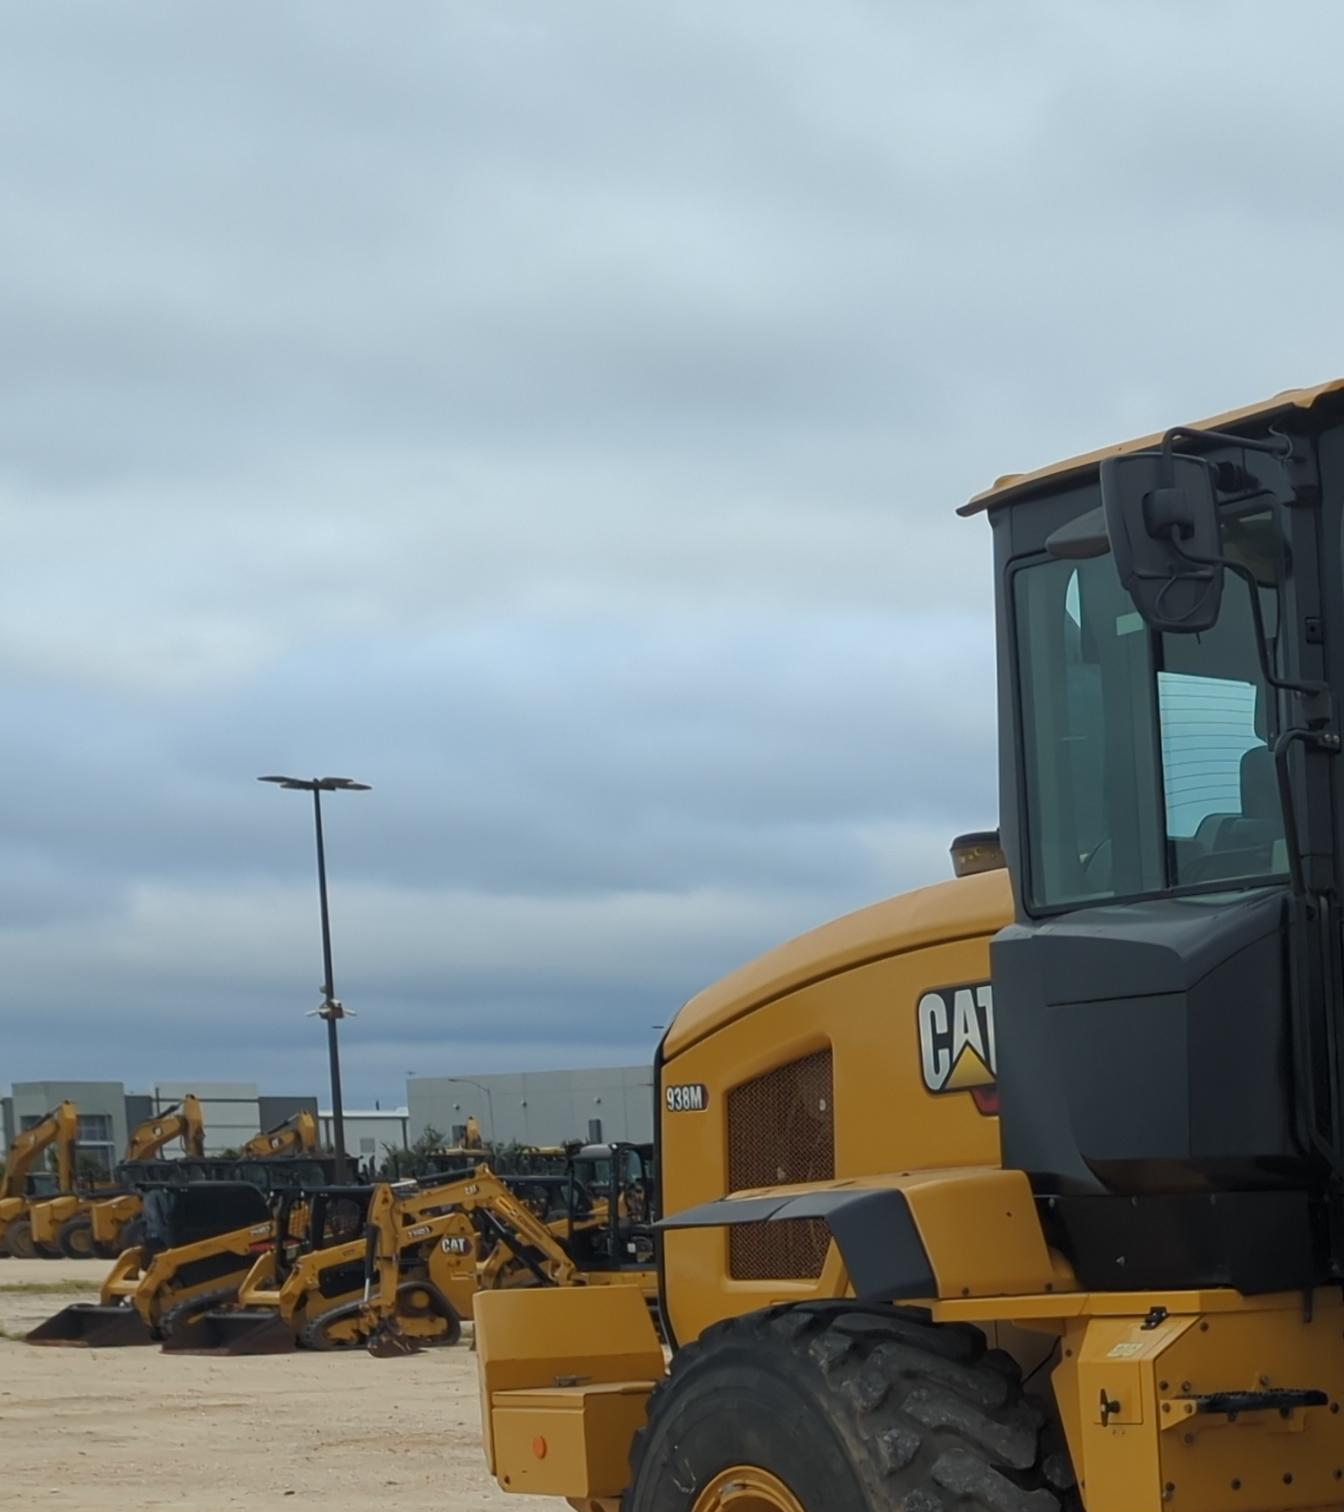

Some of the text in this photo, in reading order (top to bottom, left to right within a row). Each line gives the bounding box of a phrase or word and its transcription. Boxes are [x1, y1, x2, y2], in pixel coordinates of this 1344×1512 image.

[918, 985, 997, 1090] CAT
[666, 1085, 703, 1110] 938M
[442, 1238, 465, 1253] CAT
